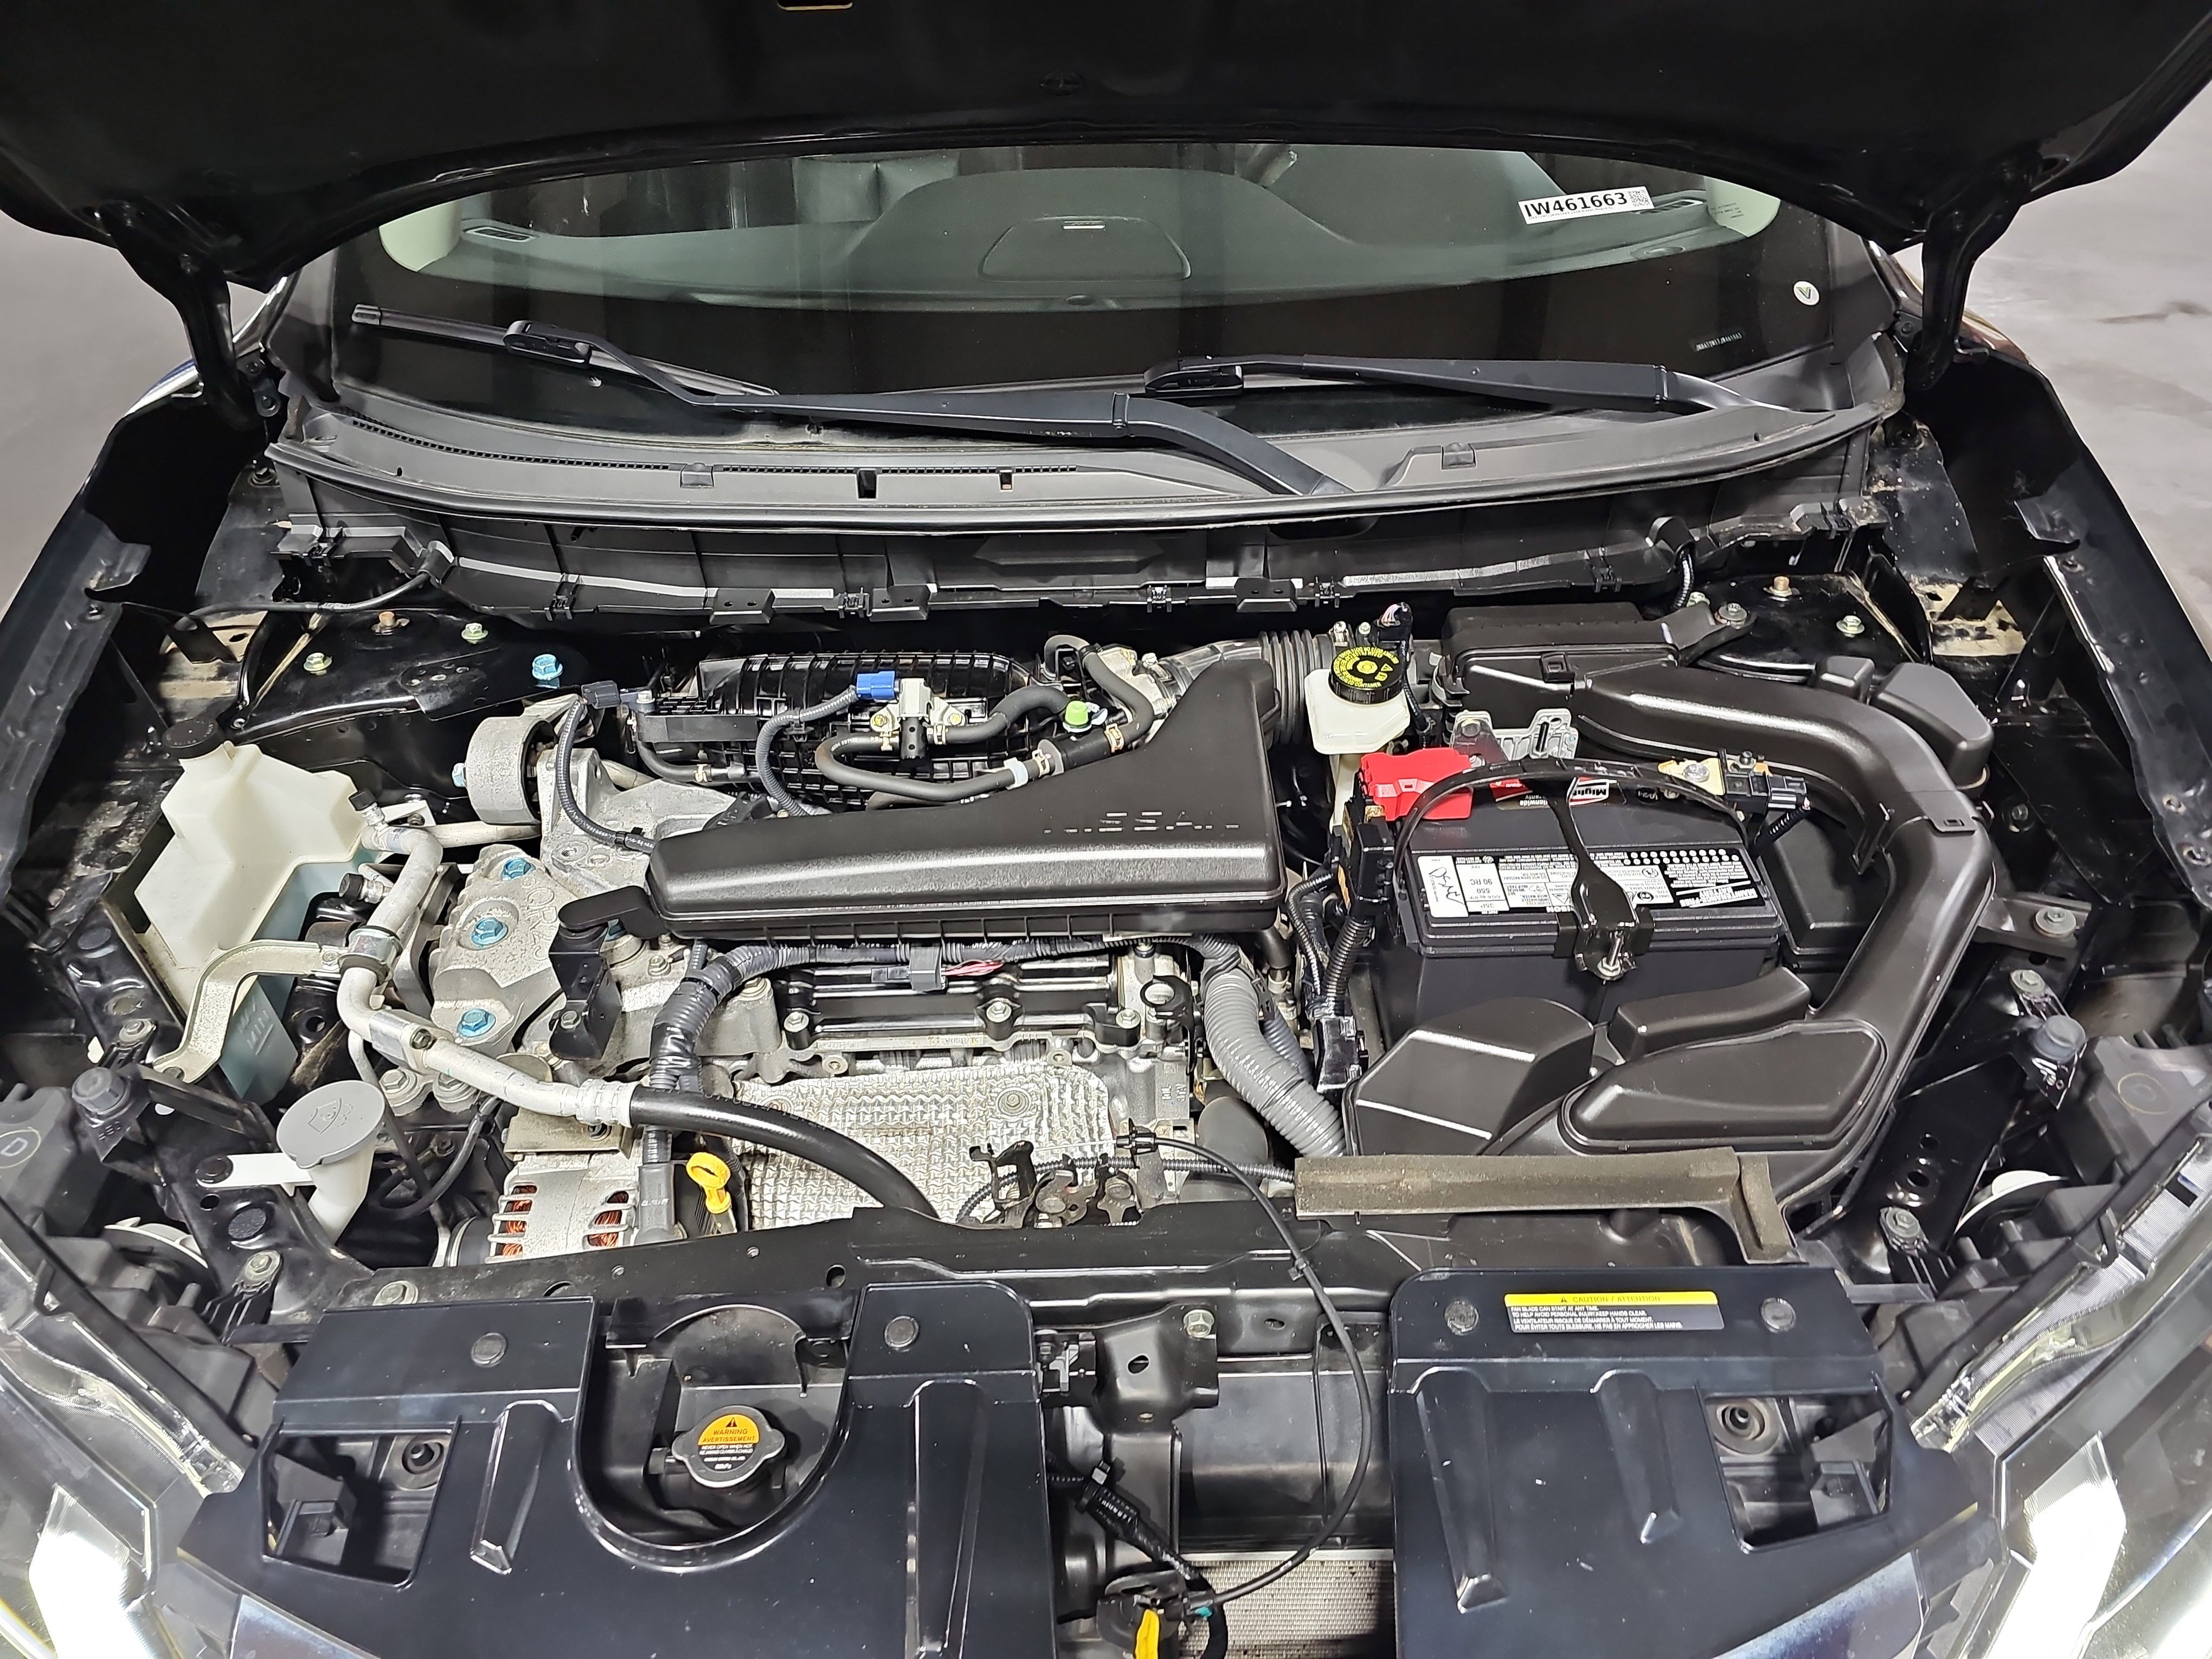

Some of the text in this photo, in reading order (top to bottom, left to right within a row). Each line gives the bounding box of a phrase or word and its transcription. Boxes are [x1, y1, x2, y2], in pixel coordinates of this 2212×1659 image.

[1525, 192, 1627, 217] IW461663
[246, 1010, 270, 1050] MIN
[1, 1137, 28, 1156] D
